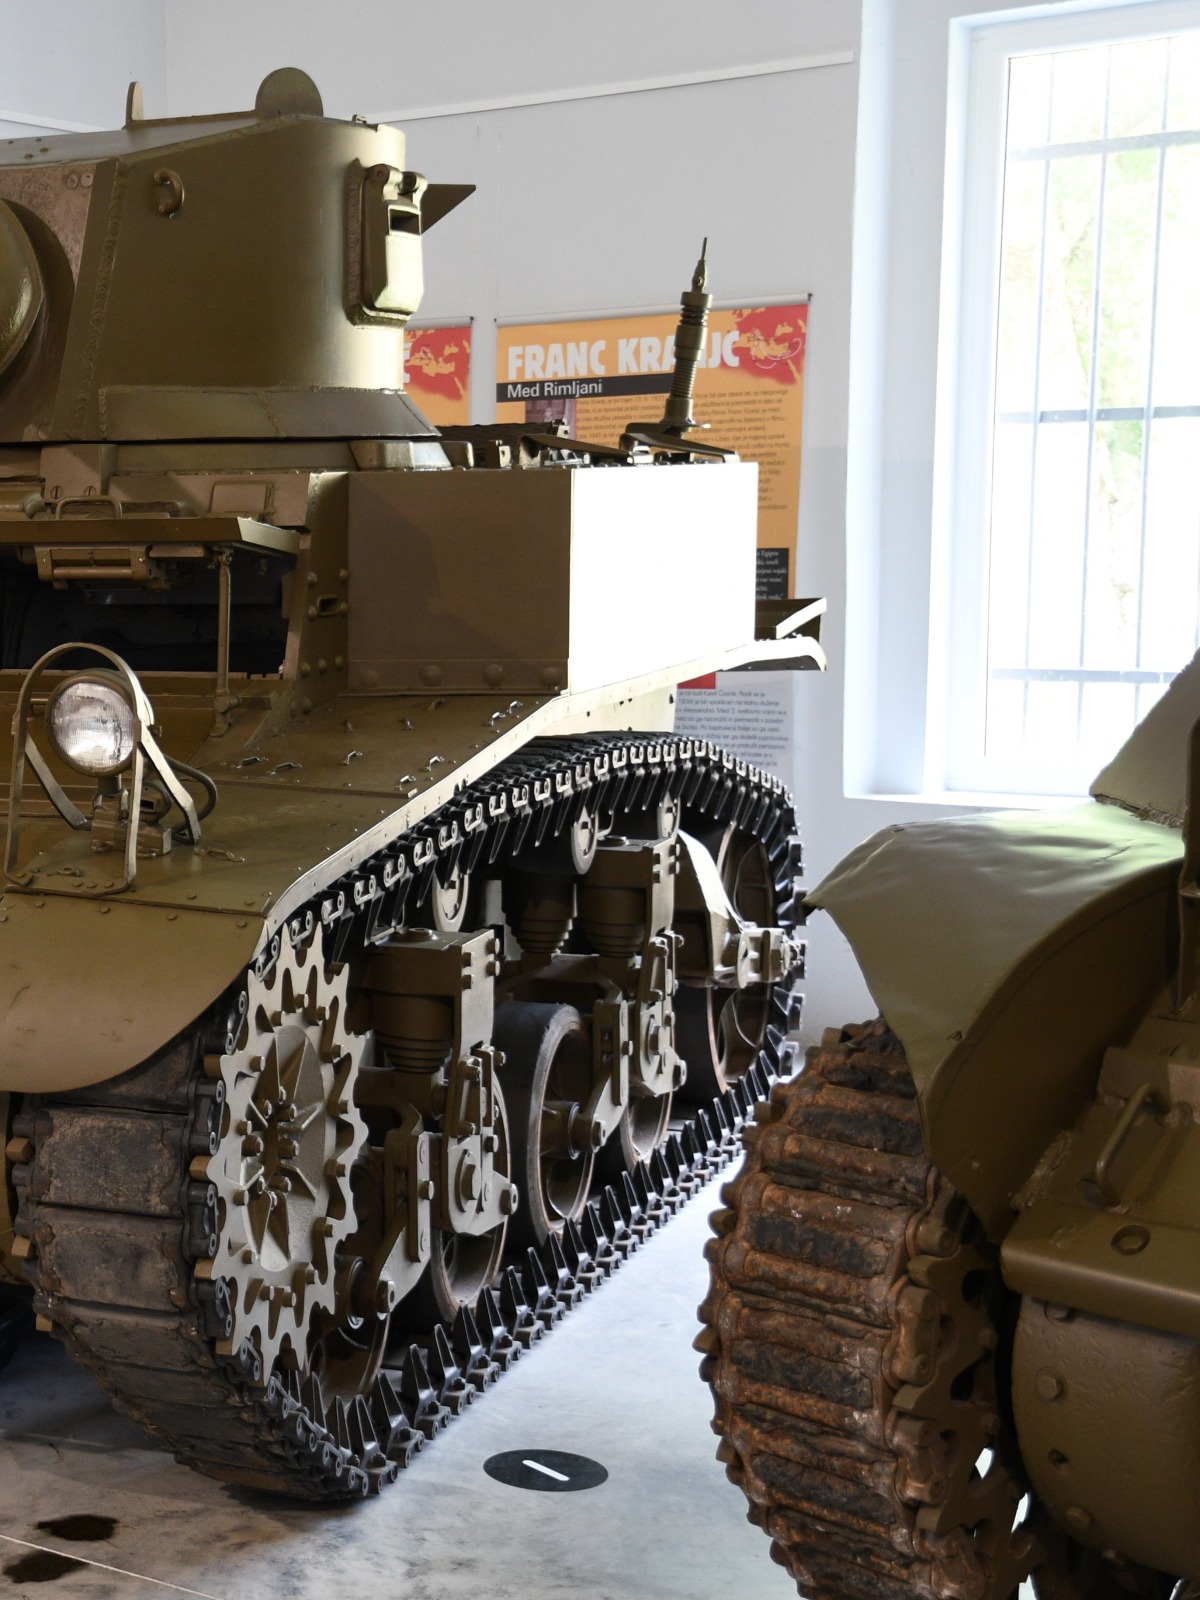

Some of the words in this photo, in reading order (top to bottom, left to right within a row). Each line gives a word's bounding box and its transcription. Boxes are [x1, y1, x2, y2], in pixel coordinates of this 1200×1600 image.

[508, 340, 605, 380] FRANC
[507, 383, 539, 398] Med
[544, 379, 602, 398] Rimljani
